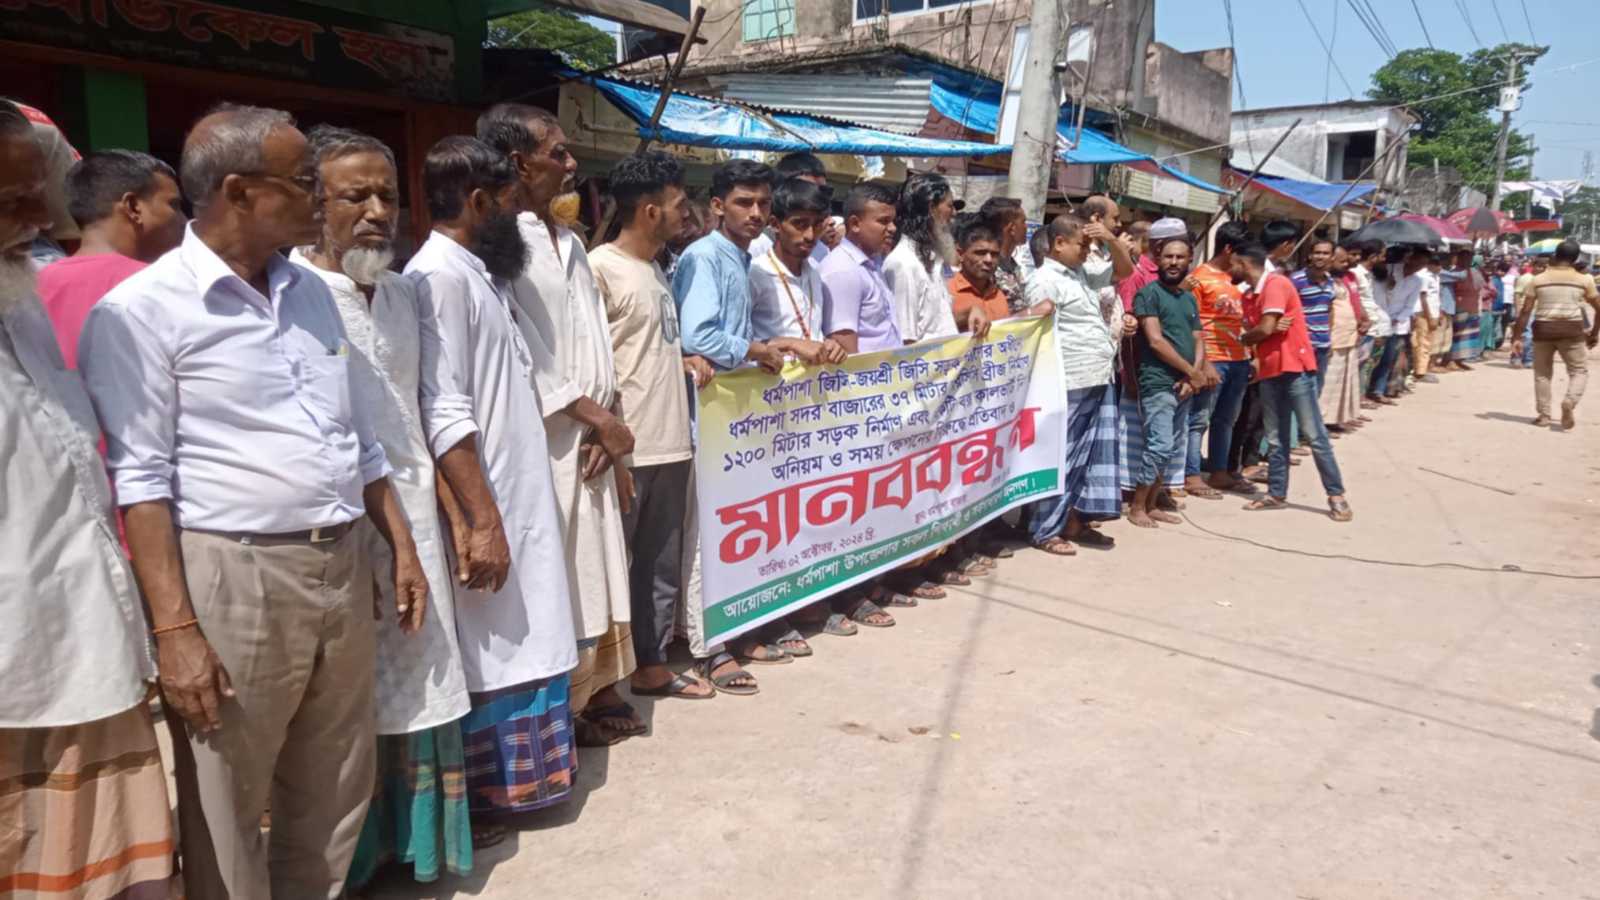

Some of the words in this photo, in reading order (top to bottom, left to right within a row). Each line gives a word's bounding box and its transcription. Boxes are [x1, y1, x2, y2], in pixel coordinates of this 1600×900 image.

[729, 411, 786, 440] ধর্মপাশা
[789, 404, 821, 425] সদর
[828, 393, 886, 418] বাজারের
[892, 391, 909, 407] ৩৭
[914, 380, 948, 402] মিটার
[981, 360, 1006, 381] ব্রীজ
[763, 379, 812, 405] ধর্মপাশা
[899, 358, 929, 381] জিসি
[723, 447, 765, 472] ১২০০
[772, 431, 812, 457] মিটার
[817, 423, 859, 446] সড়ক
[866, 411, 903, 437] নির্মাণ
[907, 410, 930, 427] এবং
[772, 454, 824, 480] অনিয়ম
[829, 453, 842, 467] ও
[848, 443, 884, 464] সময়
[715, 407, 1041, 564] মানববন্ধন
[788, 553, 800, 568] ০২
[797, 560, 840, 589] ধর্মপাশা
